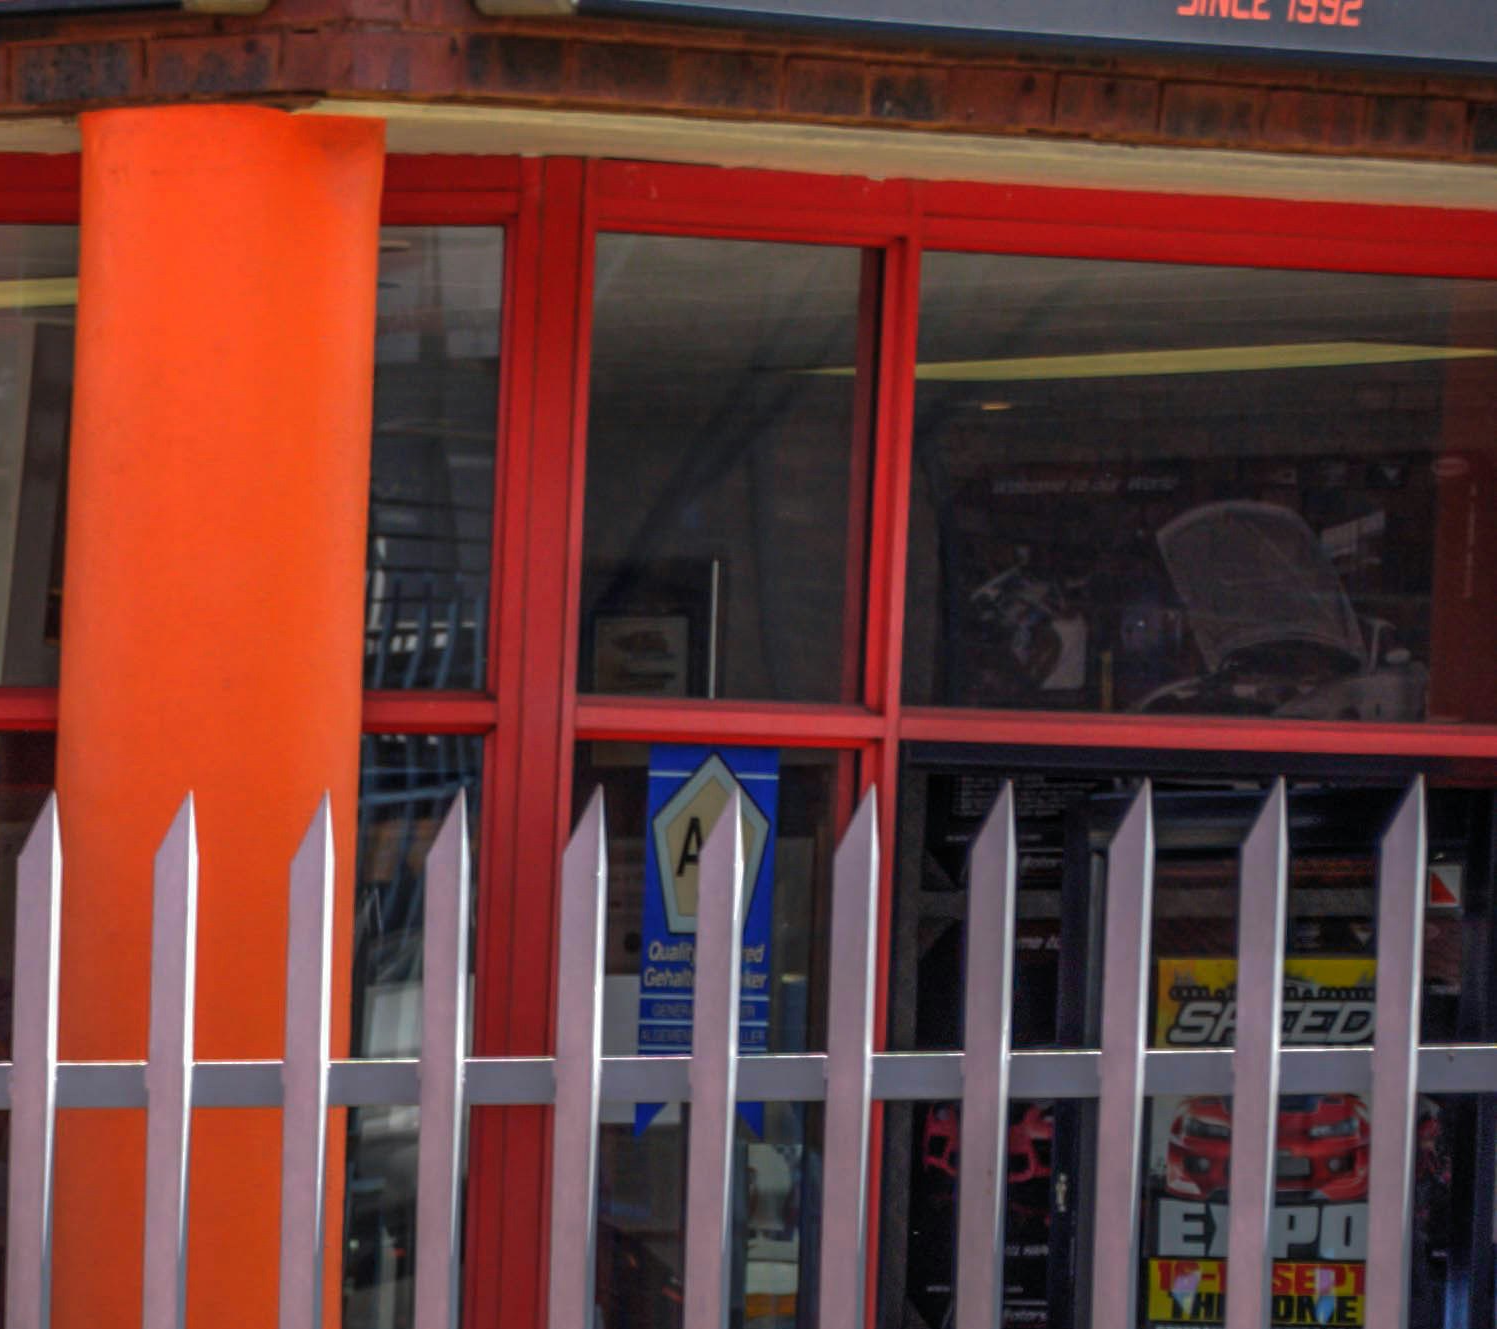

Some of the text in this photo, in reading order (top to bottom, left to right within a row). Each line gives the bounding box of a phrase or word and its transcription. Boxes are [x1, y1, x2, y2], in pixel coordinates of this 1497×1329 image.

[1286, 0, 1362, 27] 1992
[644, 969, 695, 989] Gehalt
[1272, 1263, 1366, 1296] SEPT
[1272, 1296, 1358, 1323] OME
